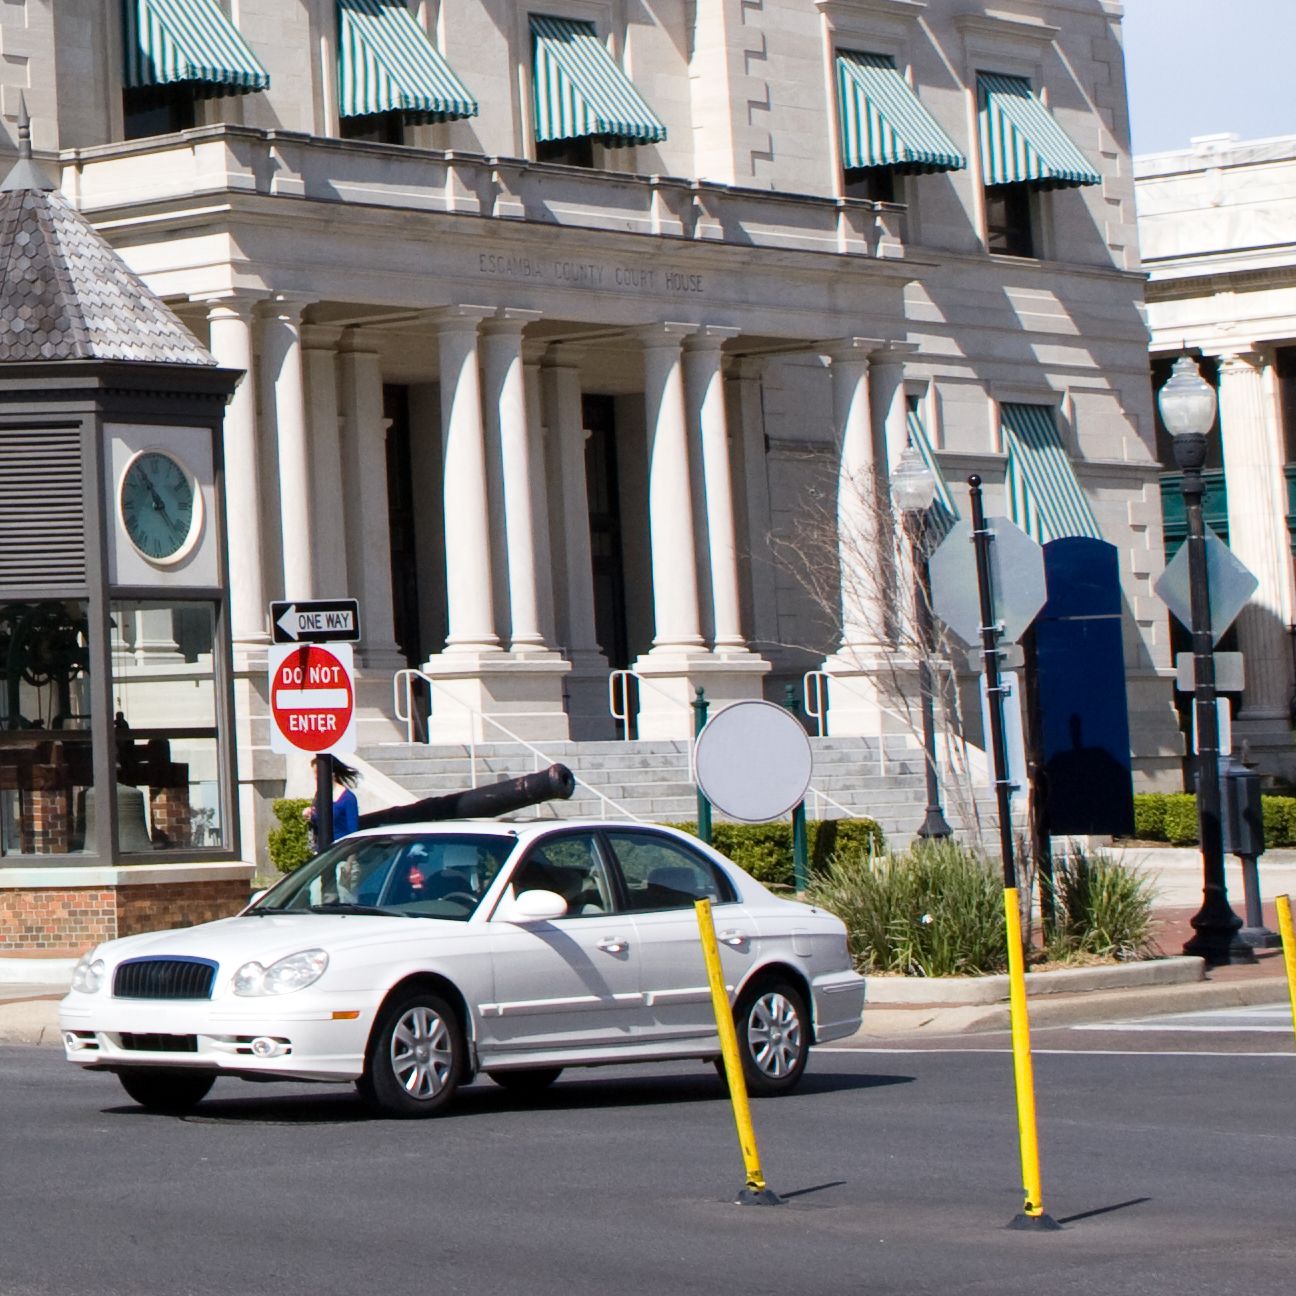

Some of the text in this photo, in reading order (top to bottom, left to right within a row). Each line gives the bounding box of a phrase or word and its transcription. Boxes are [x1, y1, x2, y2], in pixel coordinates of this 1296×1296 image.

[554, 260, 603, 284] COUNTY
[615, 267, 654, 288] COURT
[665, 271, 704, 292] HOUSE
[298, 612, 351, 630] ONE WAY
[282, 666, 341, 685] DO NOT
[289, 714, 337, 731] ENTER
